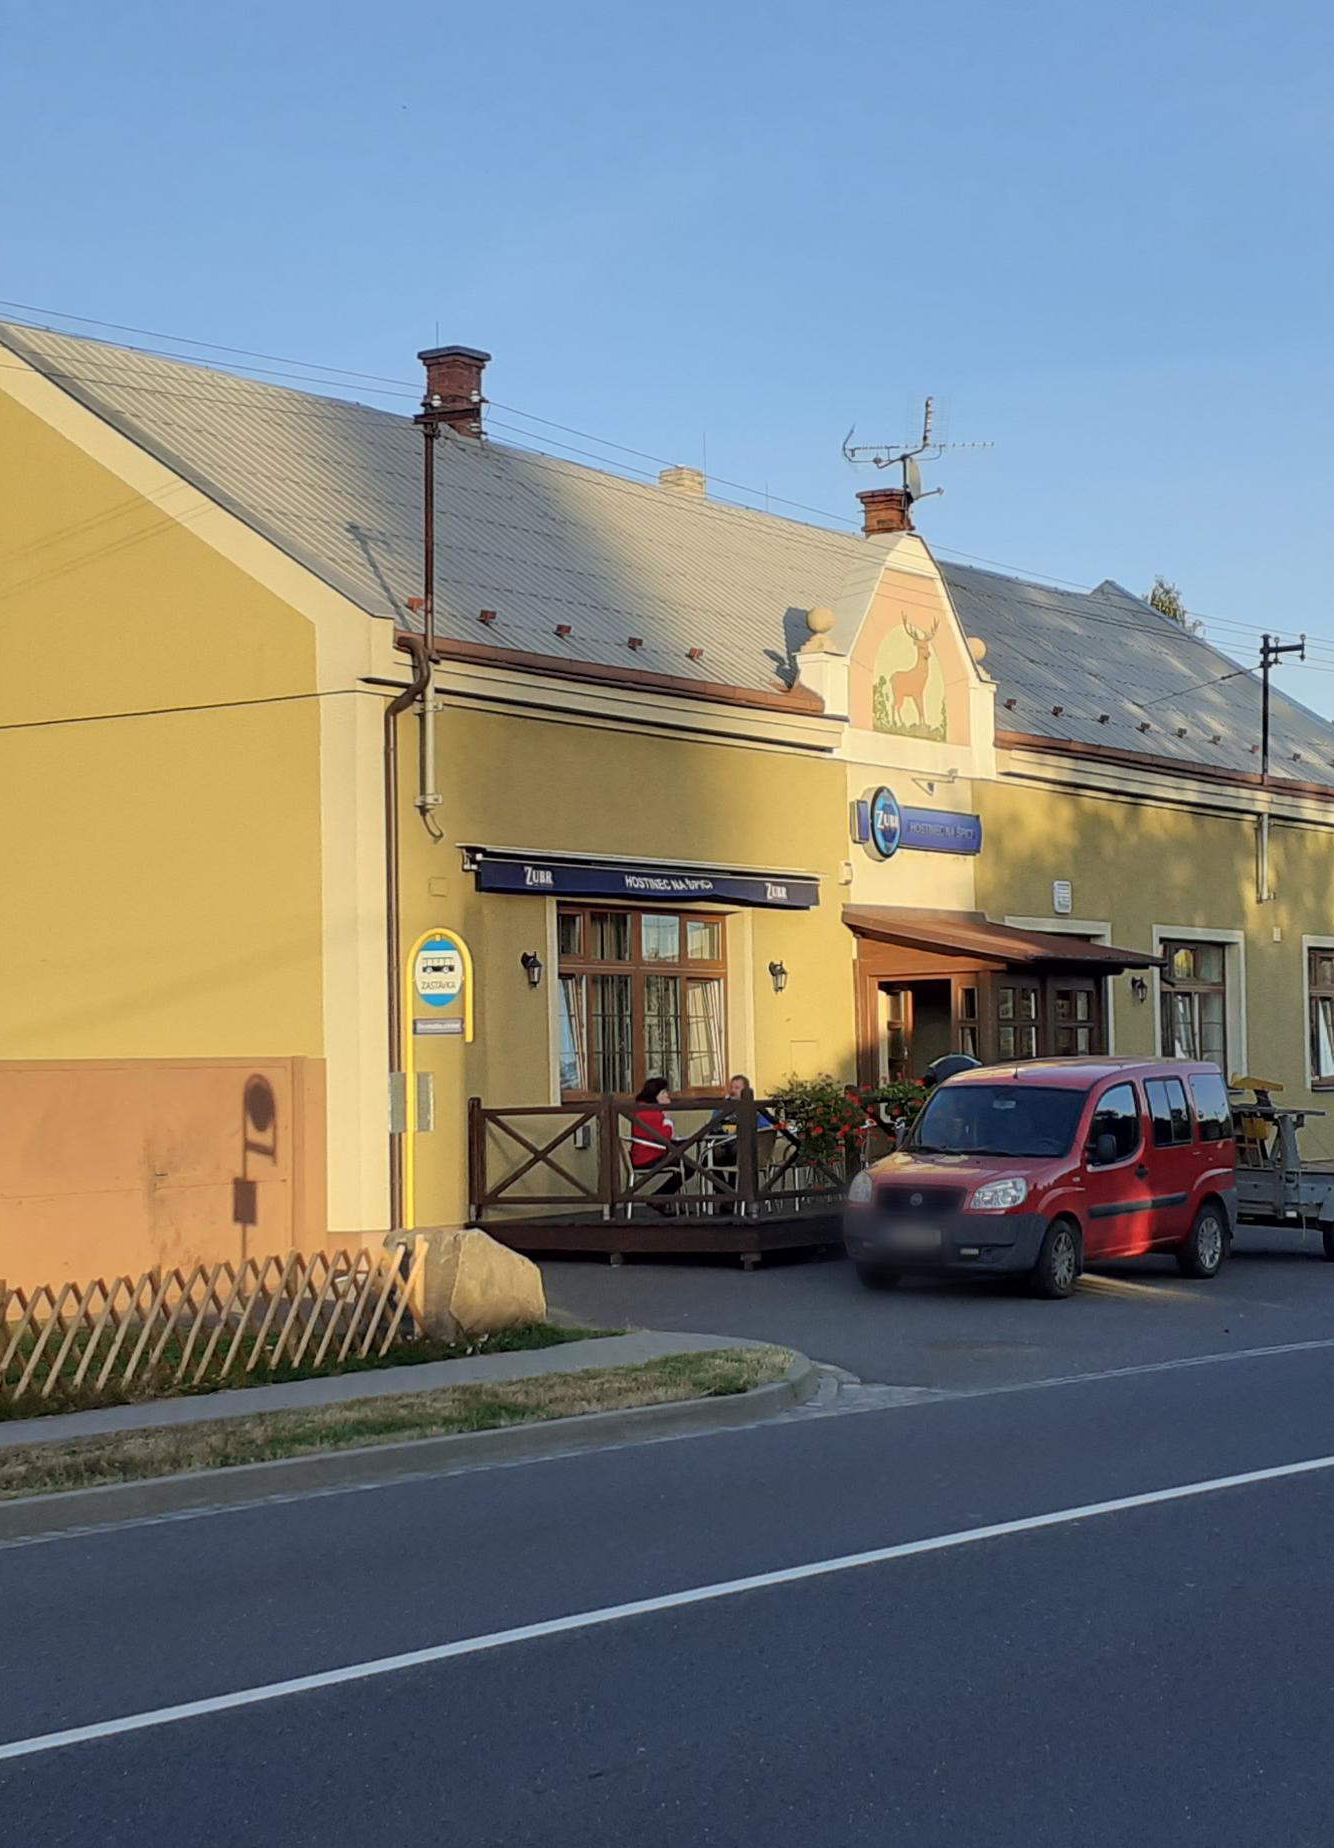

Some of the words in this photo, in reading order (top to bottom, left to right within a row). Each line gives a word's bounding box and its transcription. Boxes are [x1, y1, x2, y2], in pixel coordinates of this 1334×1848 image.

[523, 865, 554, 885] ZUBR
[624, 874, 671, 890] HOSTINEC
[671, 878, 687, 890] NA
